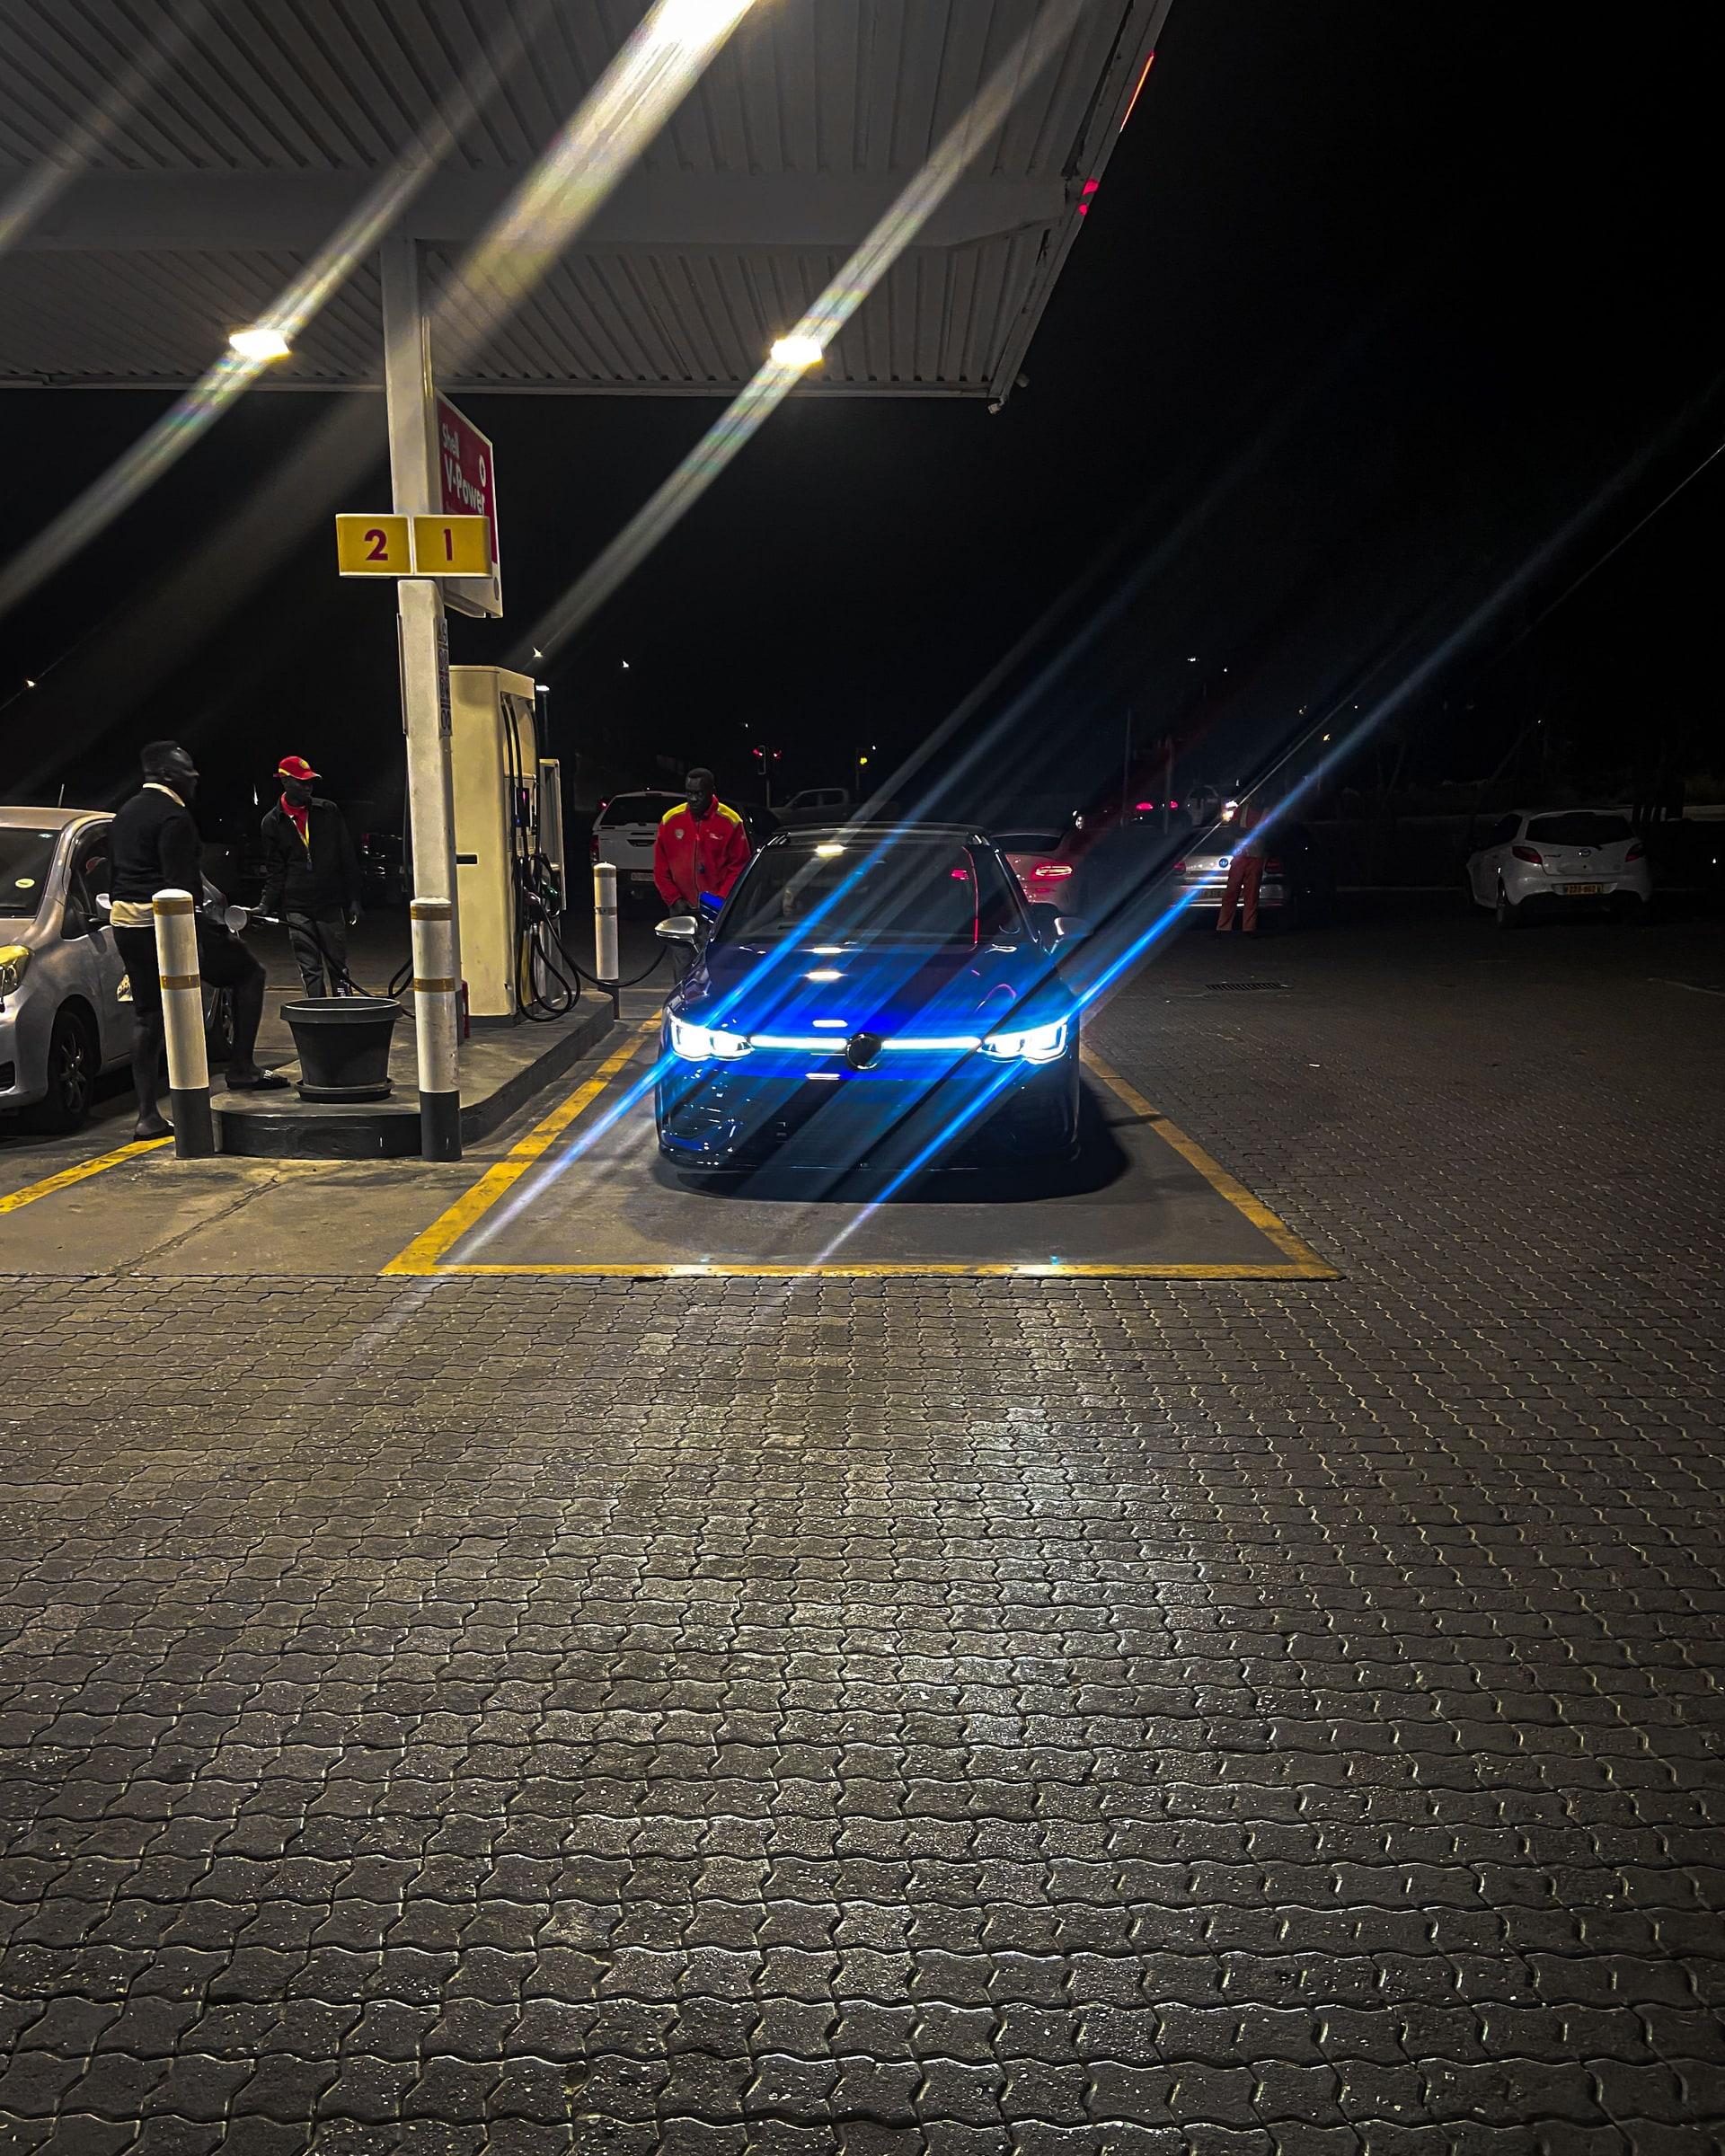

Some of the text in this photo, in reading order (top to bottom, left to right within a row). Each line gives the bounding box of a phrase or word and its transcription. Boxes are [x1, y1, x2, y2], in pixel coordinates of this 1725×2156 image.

[443, 424, 459, 459] Shell
[444, 453, 485, 515] V-Power
[364, 528, 388, 561] 2
[444, 528, 453, 561] 1
